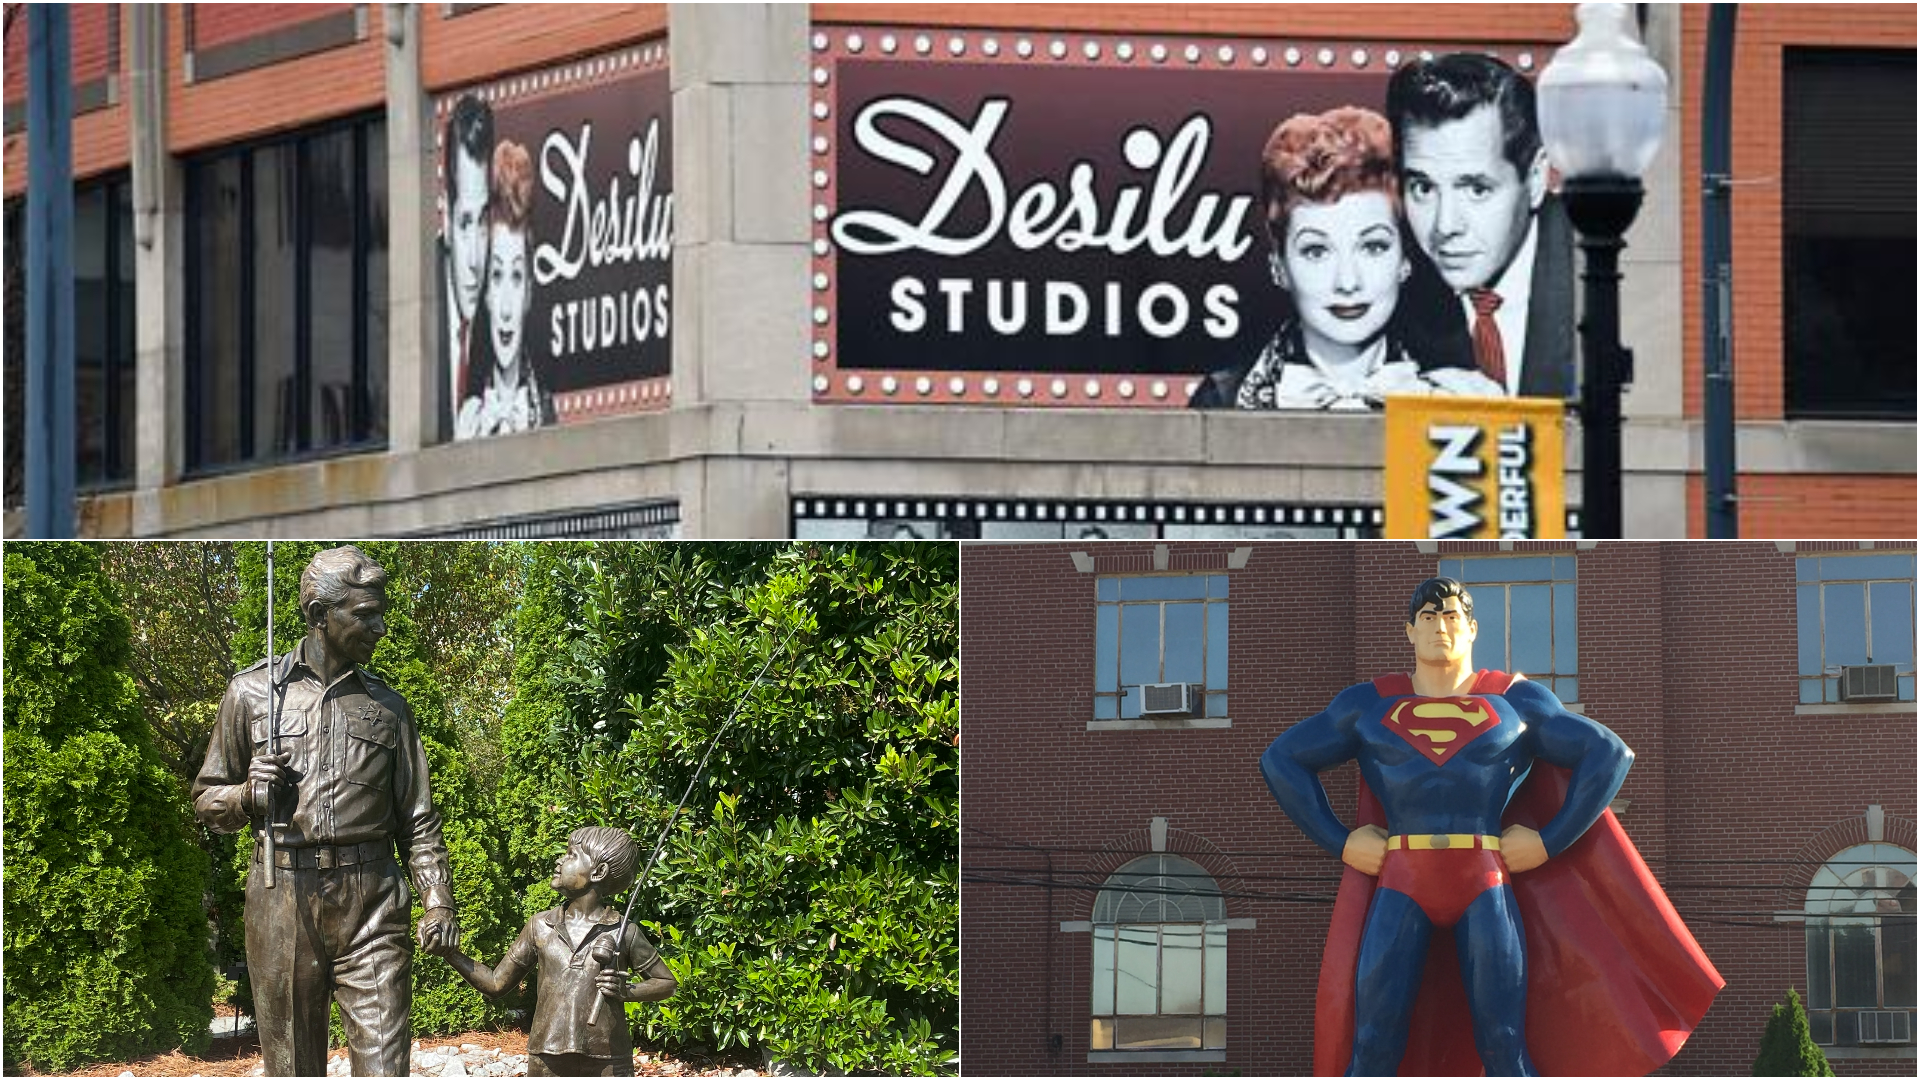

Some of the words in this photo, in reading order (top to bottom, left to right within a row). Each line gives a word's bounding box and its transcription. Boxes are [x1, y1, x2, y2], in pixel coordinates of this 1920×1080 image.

[533, 118, 673, 285] Desilu
[831, 98, 1253, 262] Desilu
[551, 284, 668, 357] STUDIOS
[890, 276, 1240, 338] STUDIOS
[1393, 697, 1487, 753] S
